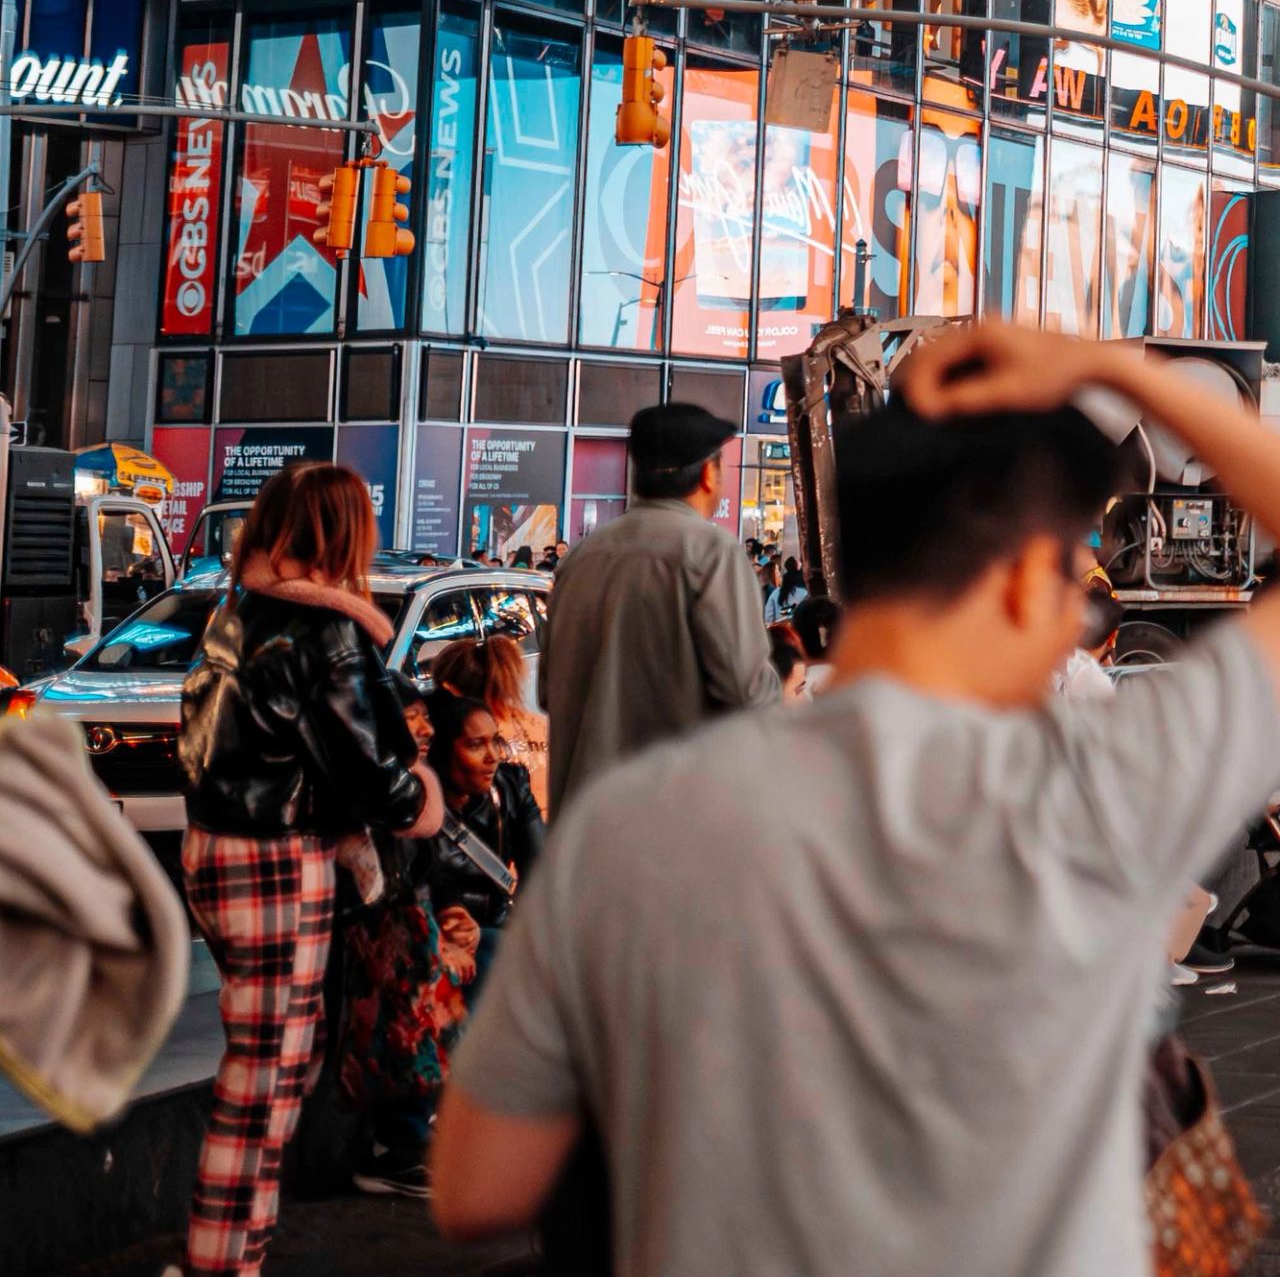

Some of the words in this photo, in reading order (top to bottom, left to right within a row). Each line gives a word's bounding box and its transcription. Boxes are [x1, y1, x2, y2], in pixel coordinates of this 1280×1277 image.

[437, 49, 462, 177] NEWS
[179, 189, 209, 276] CBS
[225, 445, 242, 457] THE
[243, 444, 305, 457] OPPORTUNITY
[472, 439, 486, 450] THE
[487, 440, 536, 452] OPPORTUNITY
[224, 457, 236, 467] OF
[238, 457, 246, 467] A
[249, 457, 284, 468] LIFETIME
[471, 451, 480, 462] OF
[481, 452, 488, 461] A
[488, 452, 520, 463] LIFETIME
